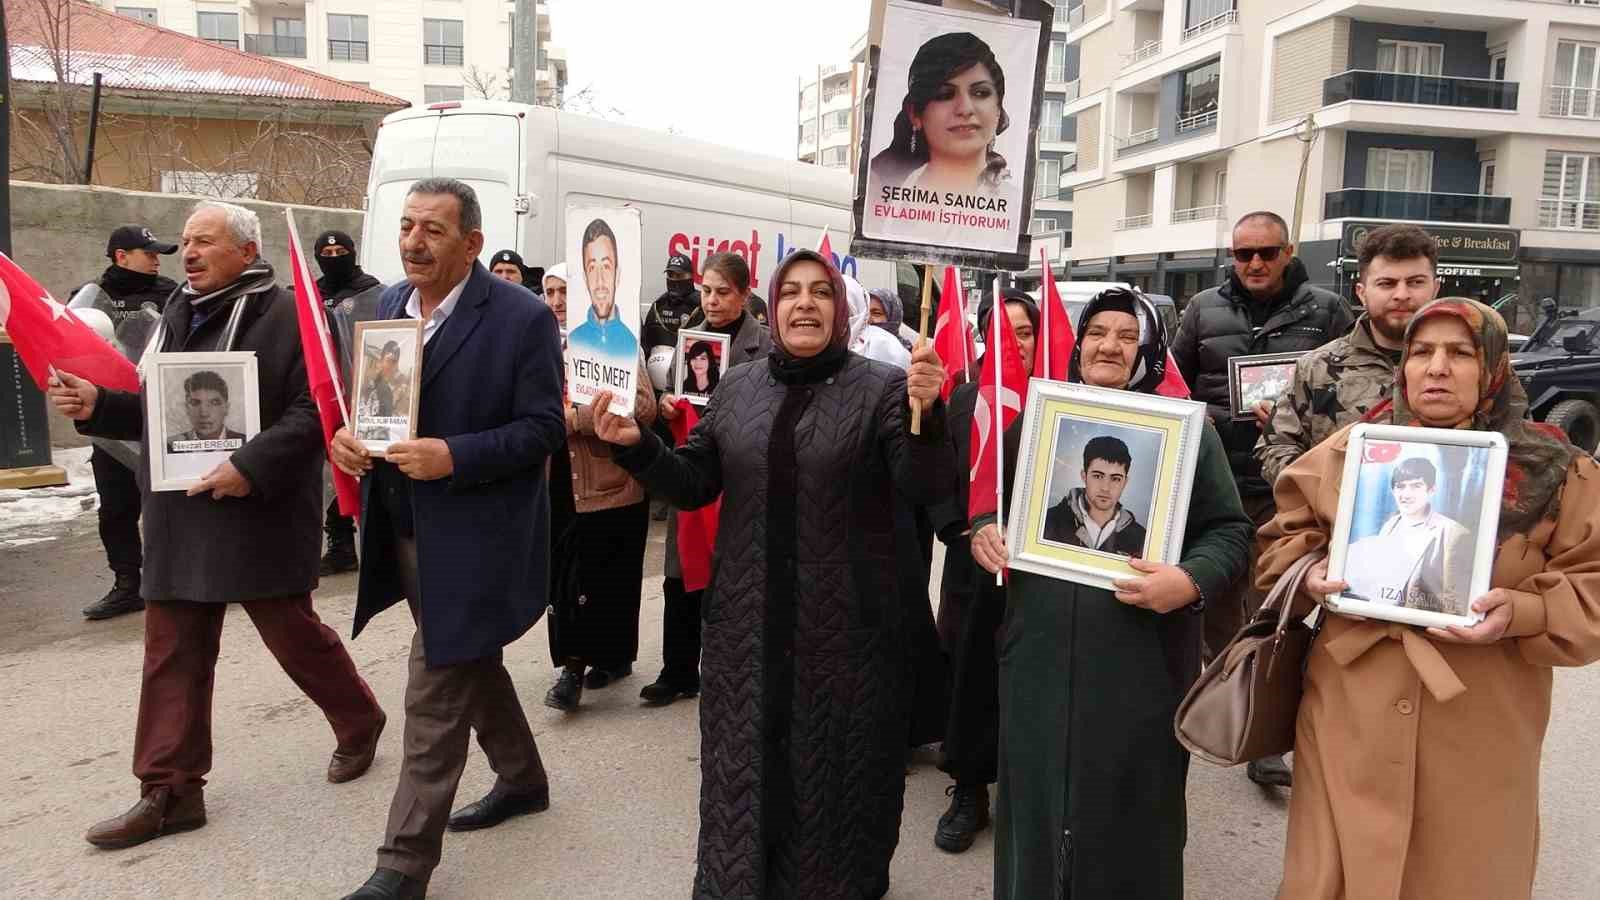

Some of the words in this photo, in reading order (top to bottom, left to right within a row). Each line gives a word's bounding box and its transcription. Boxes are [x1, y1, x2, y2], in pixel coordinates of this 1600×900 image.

[881, 185, 939, 204] ŞERİMA
[944, 193, 1008, 212] SANCAR
[874, 204, 935, 223] EVLADIMI
[939, 210, 1010, 231] İSTİYORUM!
[1451, 236, 1461, 248] &
[1464, 235, 1510, 249] Breakfast
[668, 229, 761, 289] Süt
[1436, 267, 1481, 276] COFFEE
[573, 357, 600, 387] YETİŞ
[602, 364, 631, 391] MERT
